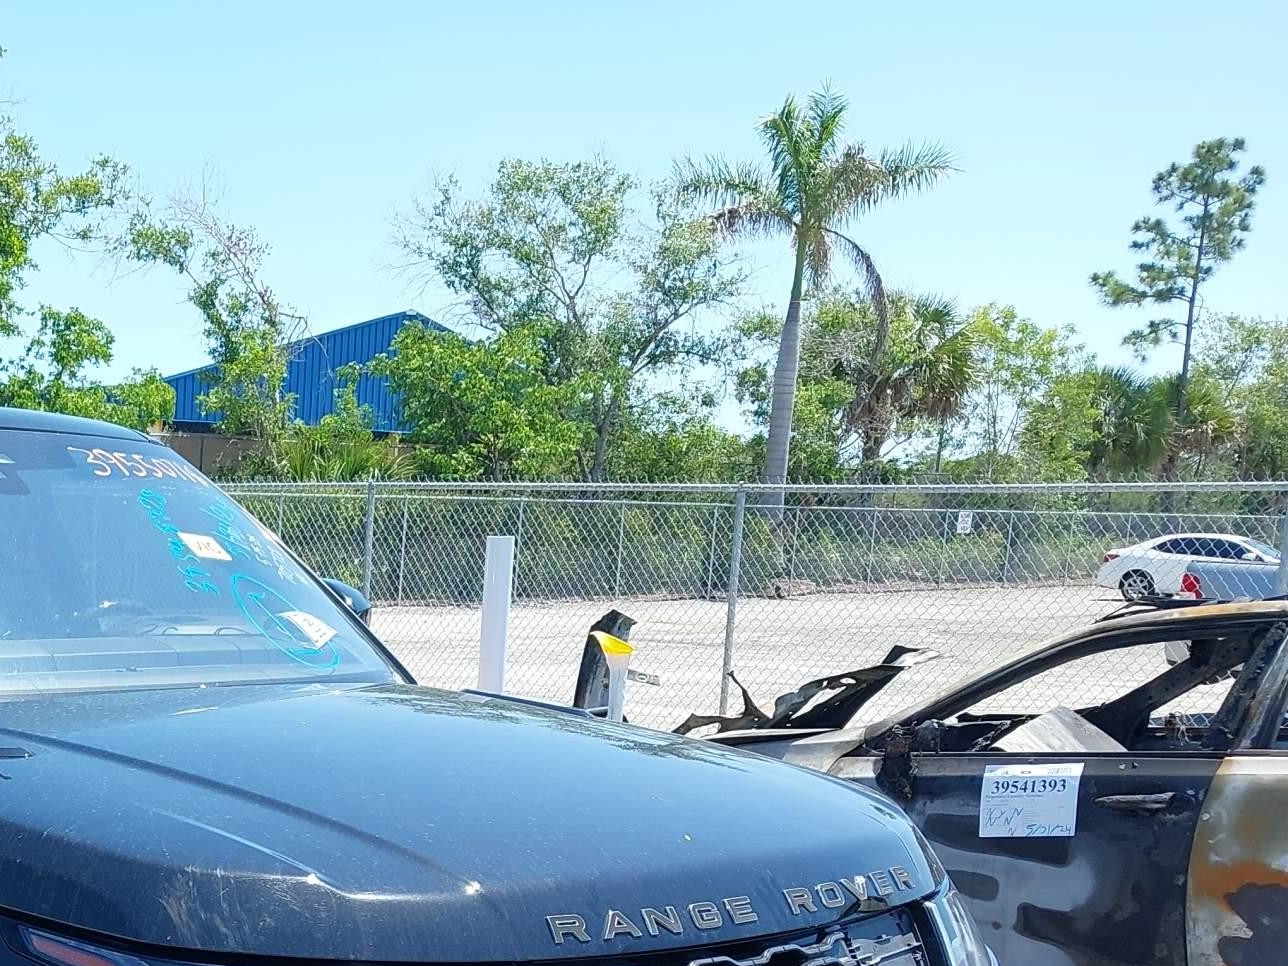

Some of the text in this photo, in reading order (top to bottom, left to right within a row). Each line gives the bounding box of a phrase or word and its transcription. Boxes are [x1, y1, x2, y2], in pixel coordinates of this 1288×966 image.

[990, 778, 1067, 795] 39541393
[545, 866, 915, 944] RANGE ROVER
